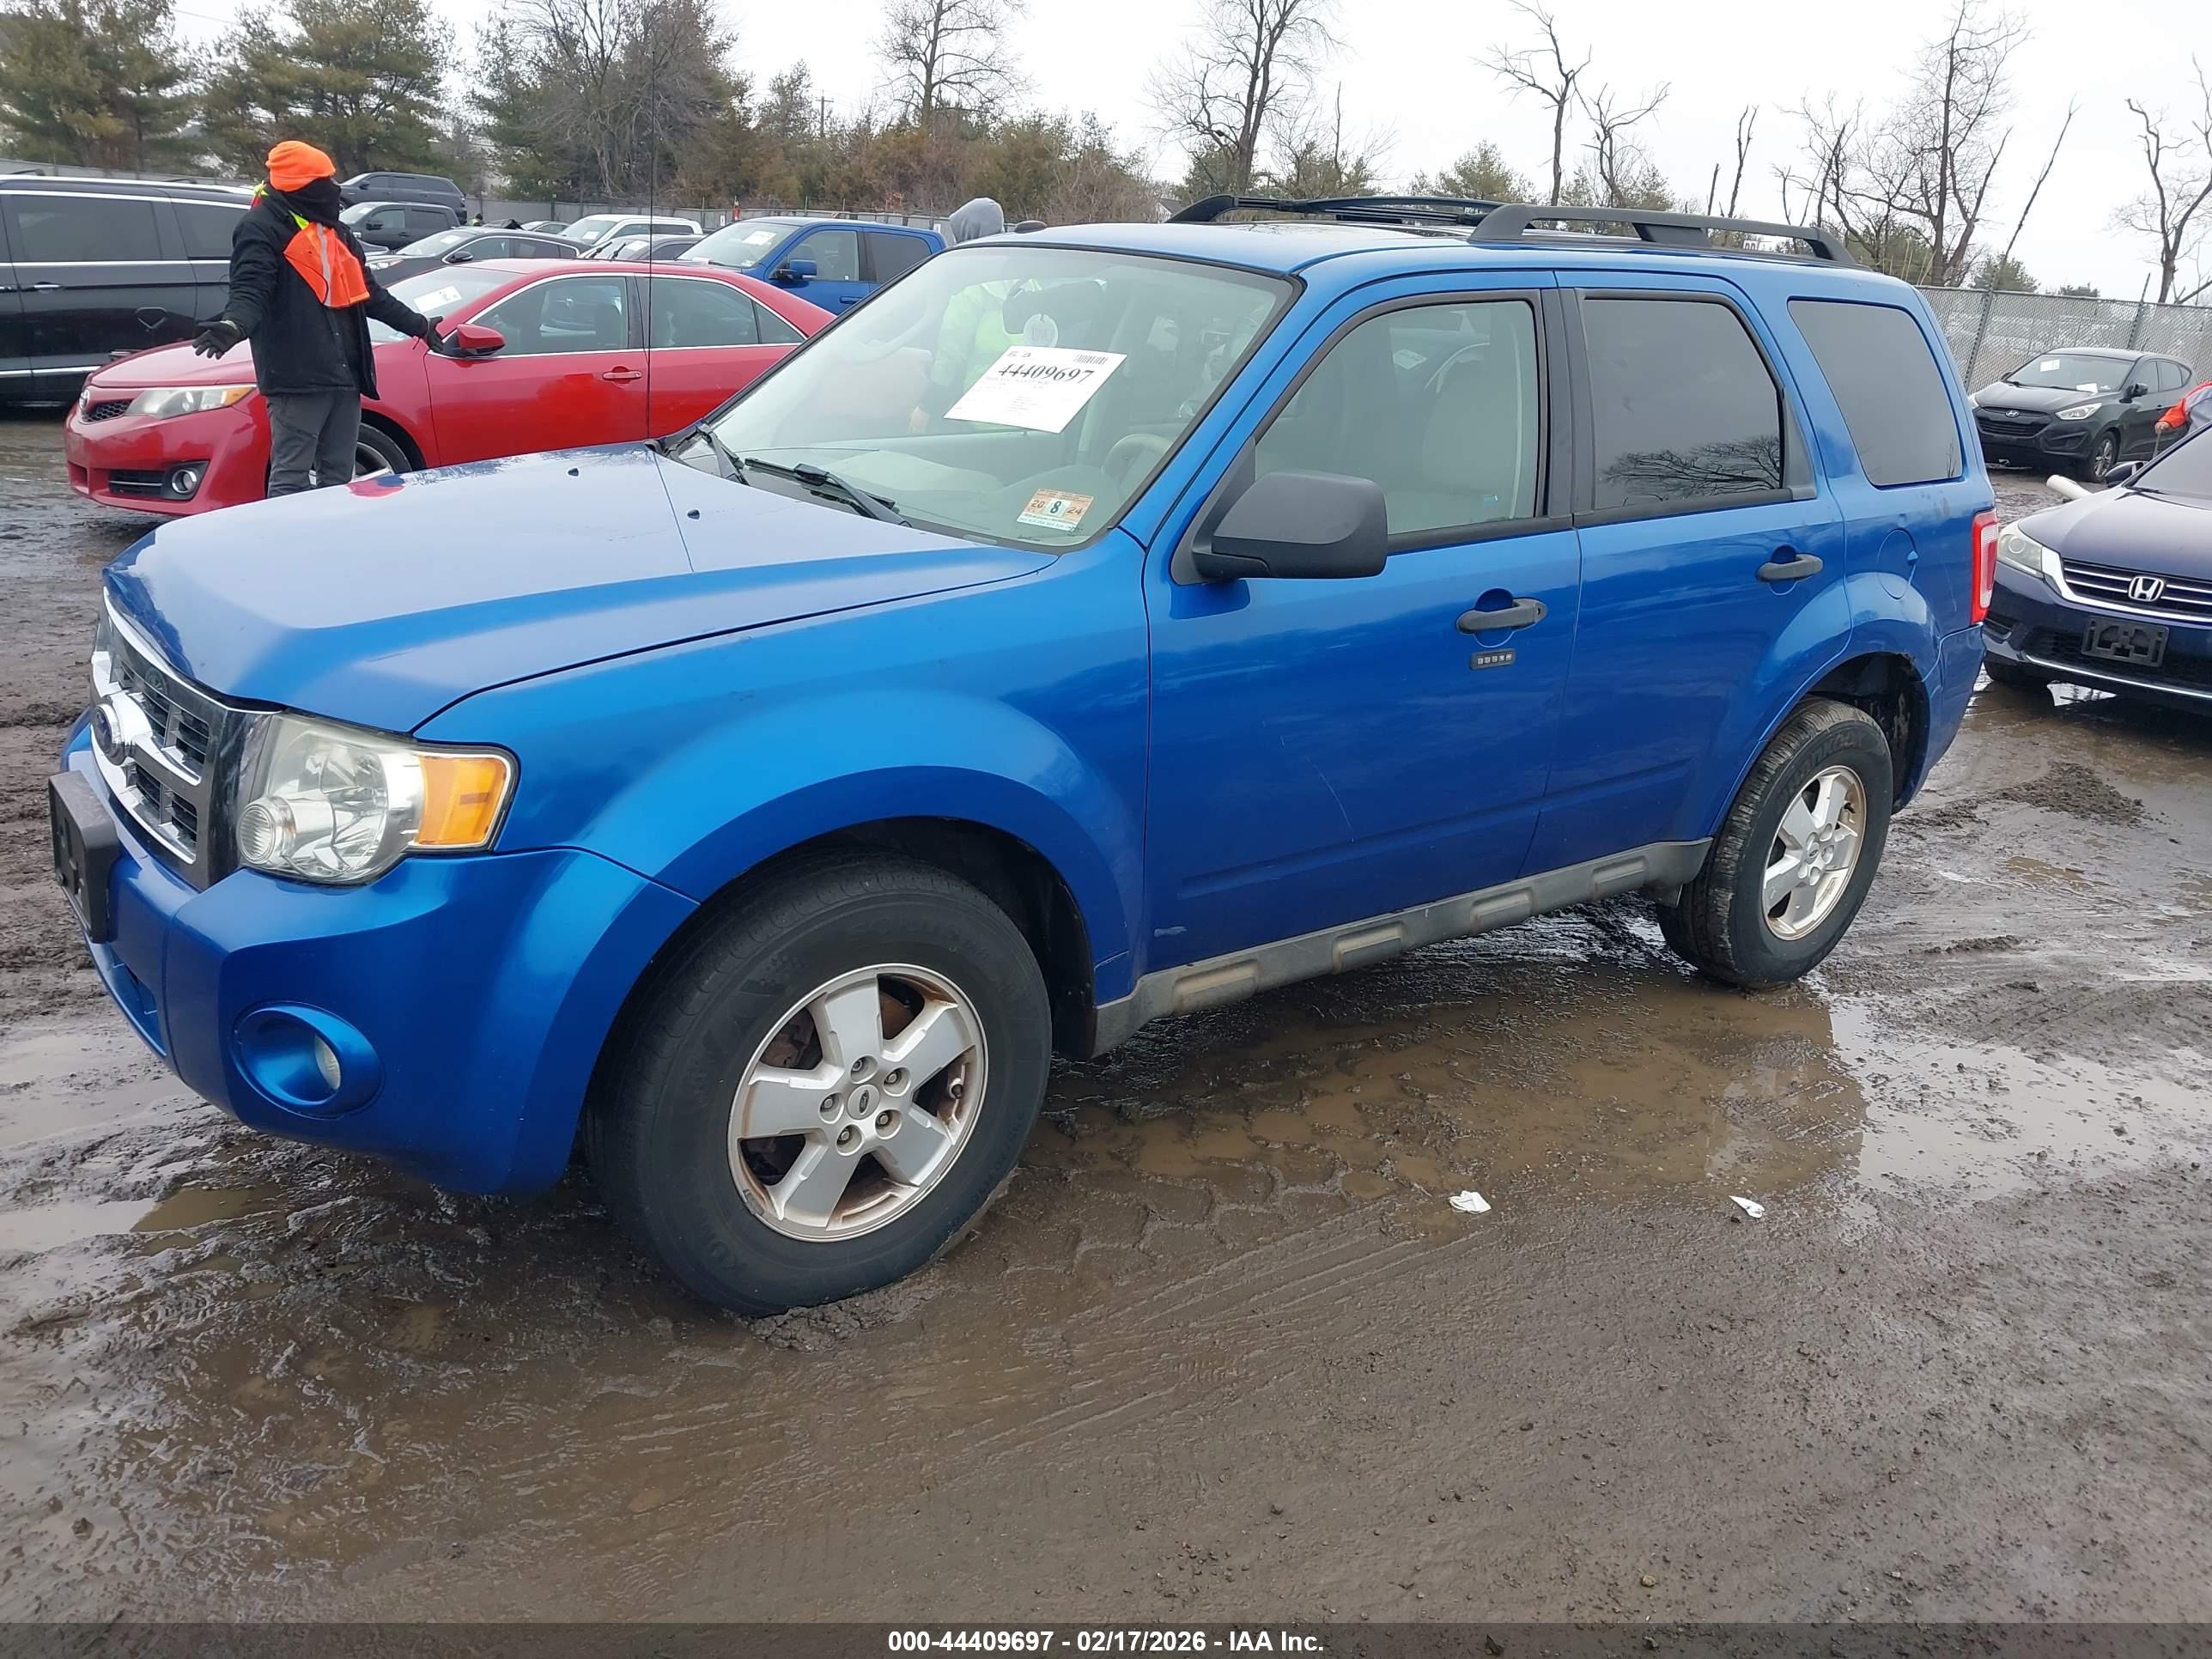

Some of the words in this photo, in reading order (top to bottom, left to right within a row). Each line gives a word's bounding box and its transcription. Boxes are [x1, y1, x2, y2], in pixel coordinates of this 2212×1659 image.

[999, 363, 1095, 384] 44409697
[1030, 500, 1045, 508] 20
[1049, 501, 1062, 514] 8
